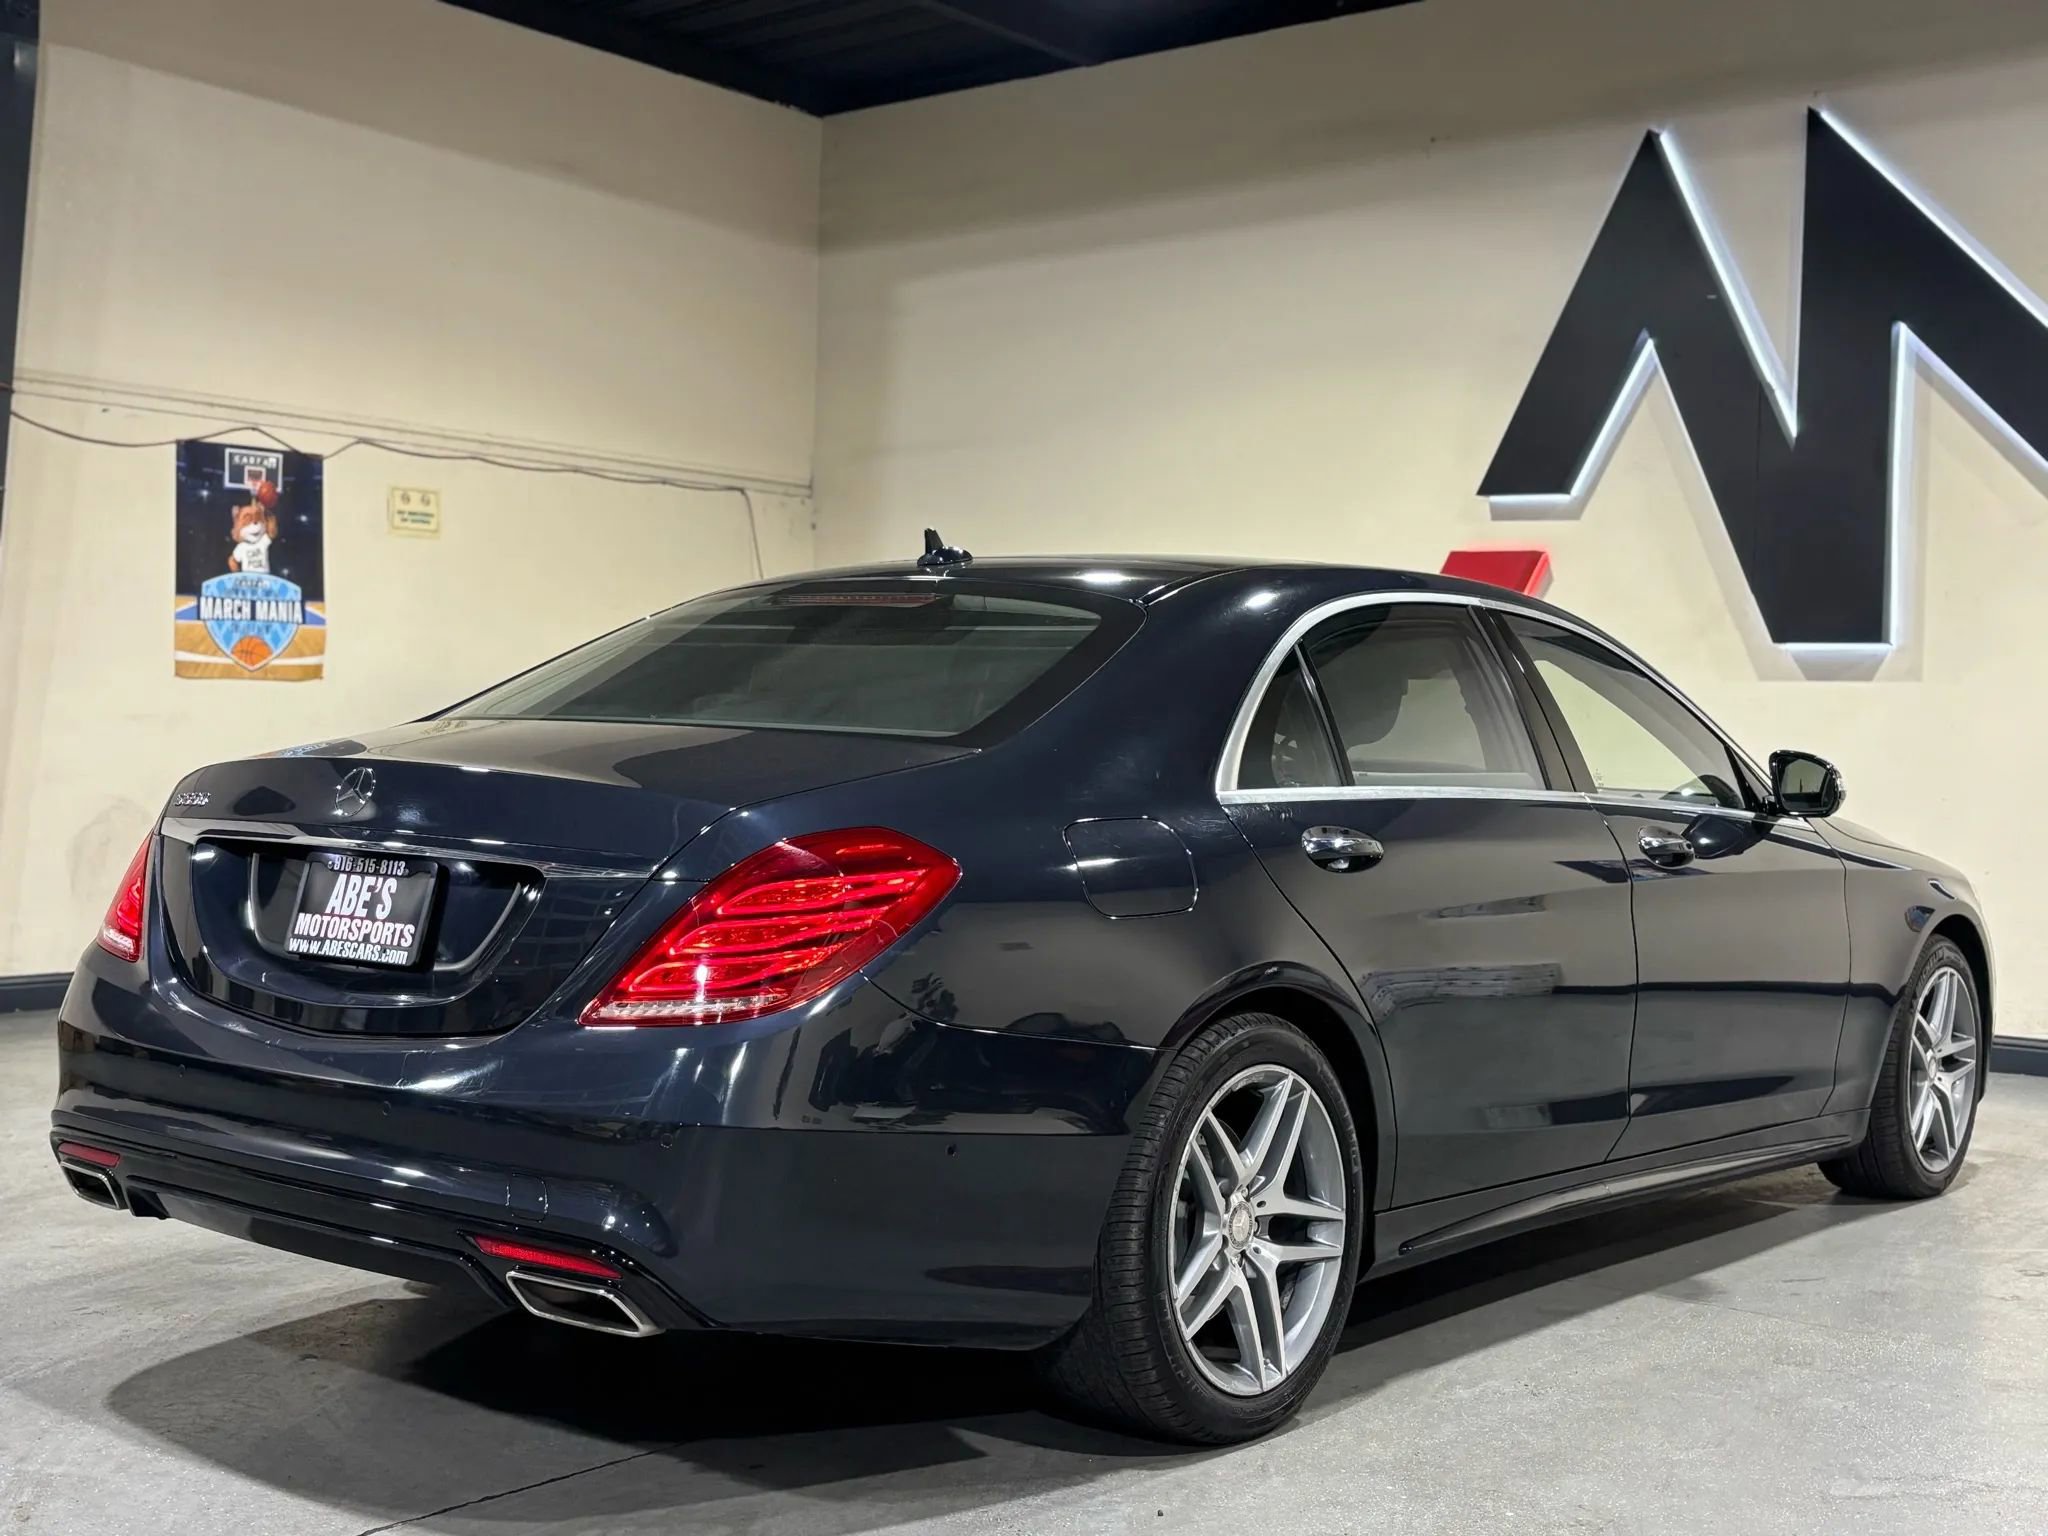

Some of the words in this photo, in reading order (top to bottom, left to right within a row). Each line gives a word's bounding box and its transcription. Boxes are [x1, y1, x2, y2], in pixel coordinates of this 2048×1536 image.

[200, 596, 251, 620] MARCH
[255, 600, 303, 624] MANIA
[333, 854, 406, 876] 916-515-8113
[325, 873, 398, 921] ABE'S
[294, 912, 416, 948] MOTORSPORTS
